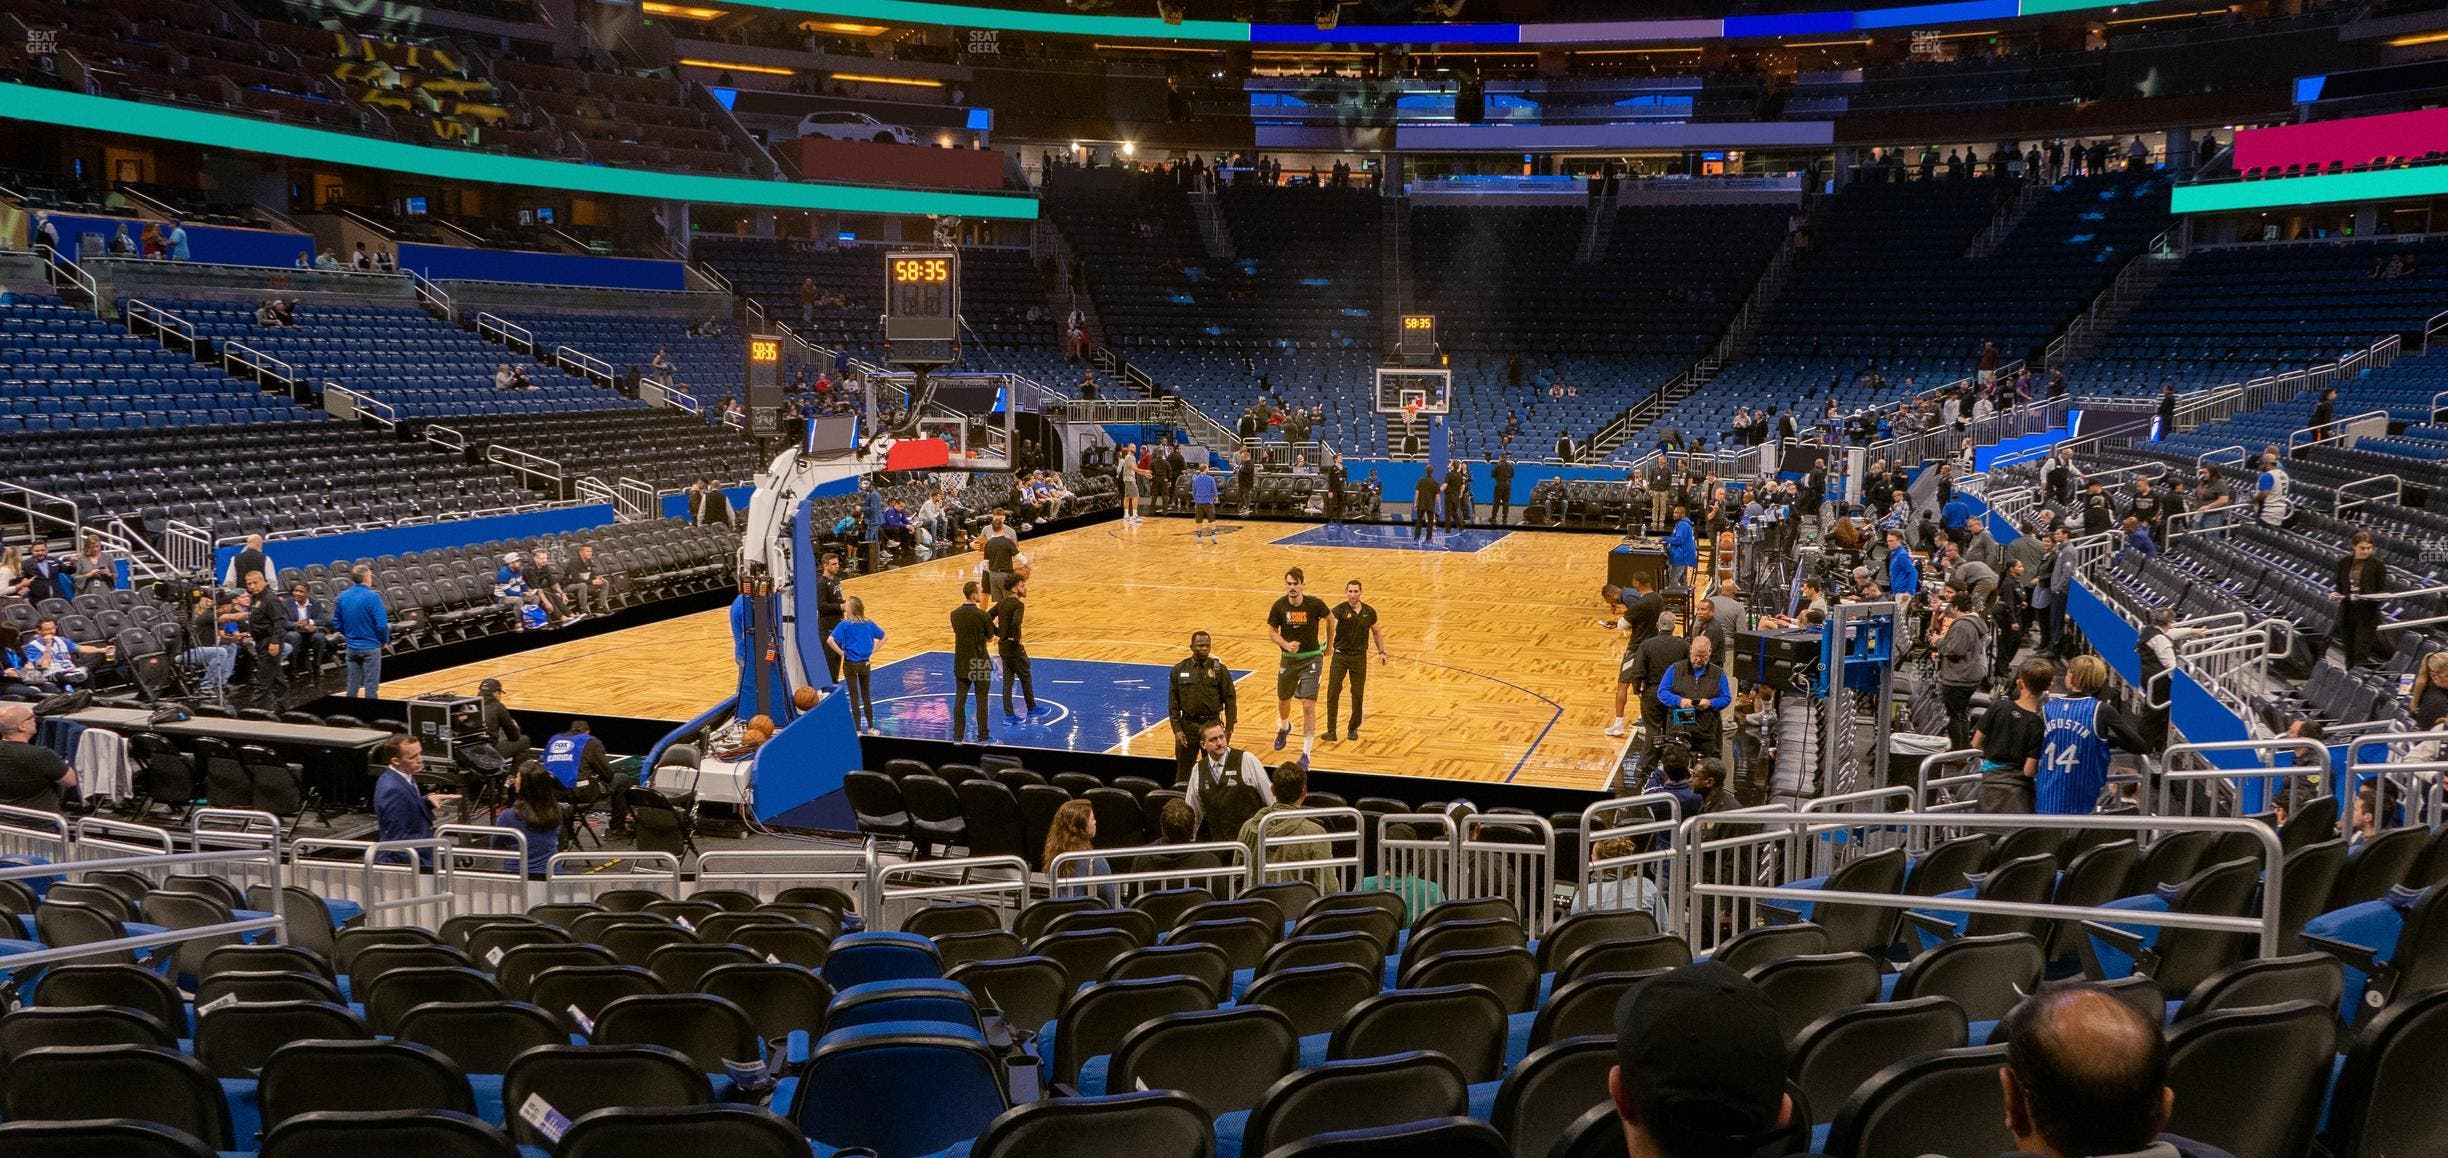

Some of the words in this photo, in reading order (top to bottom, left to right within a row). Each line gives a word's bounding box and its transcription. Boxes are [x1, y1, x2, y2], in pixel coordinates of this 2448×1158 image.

[895, 260, 947, 282] 58:35
[1404, 317, 1432, 329] 58:35
[2044, 742, 2081, 774] 14
